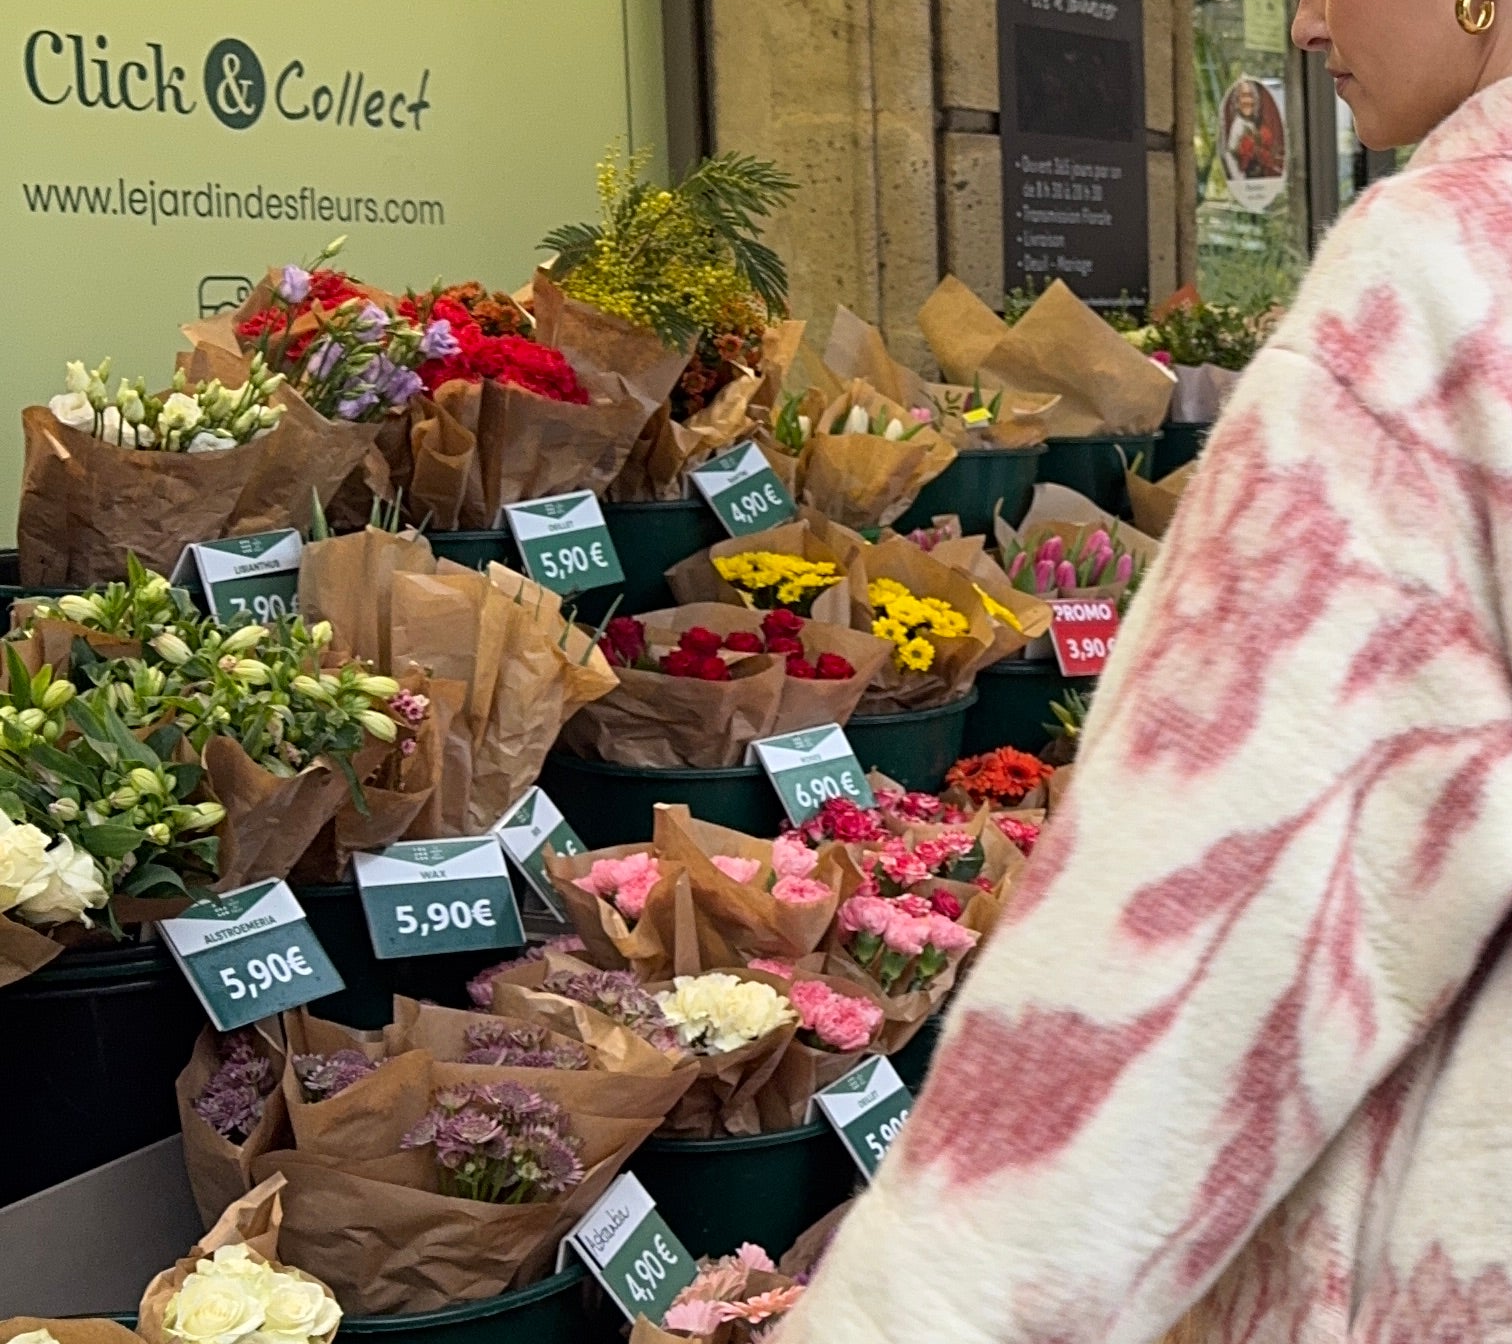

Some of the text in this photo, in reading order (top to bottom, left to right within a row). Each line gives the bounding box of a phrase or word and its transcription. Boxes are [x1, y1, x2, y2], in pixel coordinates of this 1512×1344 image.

[23, 28, 433, 132] Click & Collect
[22, 176, 445, 229] www.lejardindesfleurs.com
[730, 490, 769, 524] 4,90
[540, 541, 609, 579] 5,90 €
[1052, 603, 1112, 622] PROMO
[1066, 637, 1106, 662] 3,90
[795, 775, 841, 809] 6,90
[420, 870, 448, 880] WAX
[203, 915, 278, 945] ALSTROEMERIA
[395, 898, 497, 937] 5,90€
[219, 945, 313, 1000] 5,90€
[625, 1233, 679, 1302] 4,90 €
